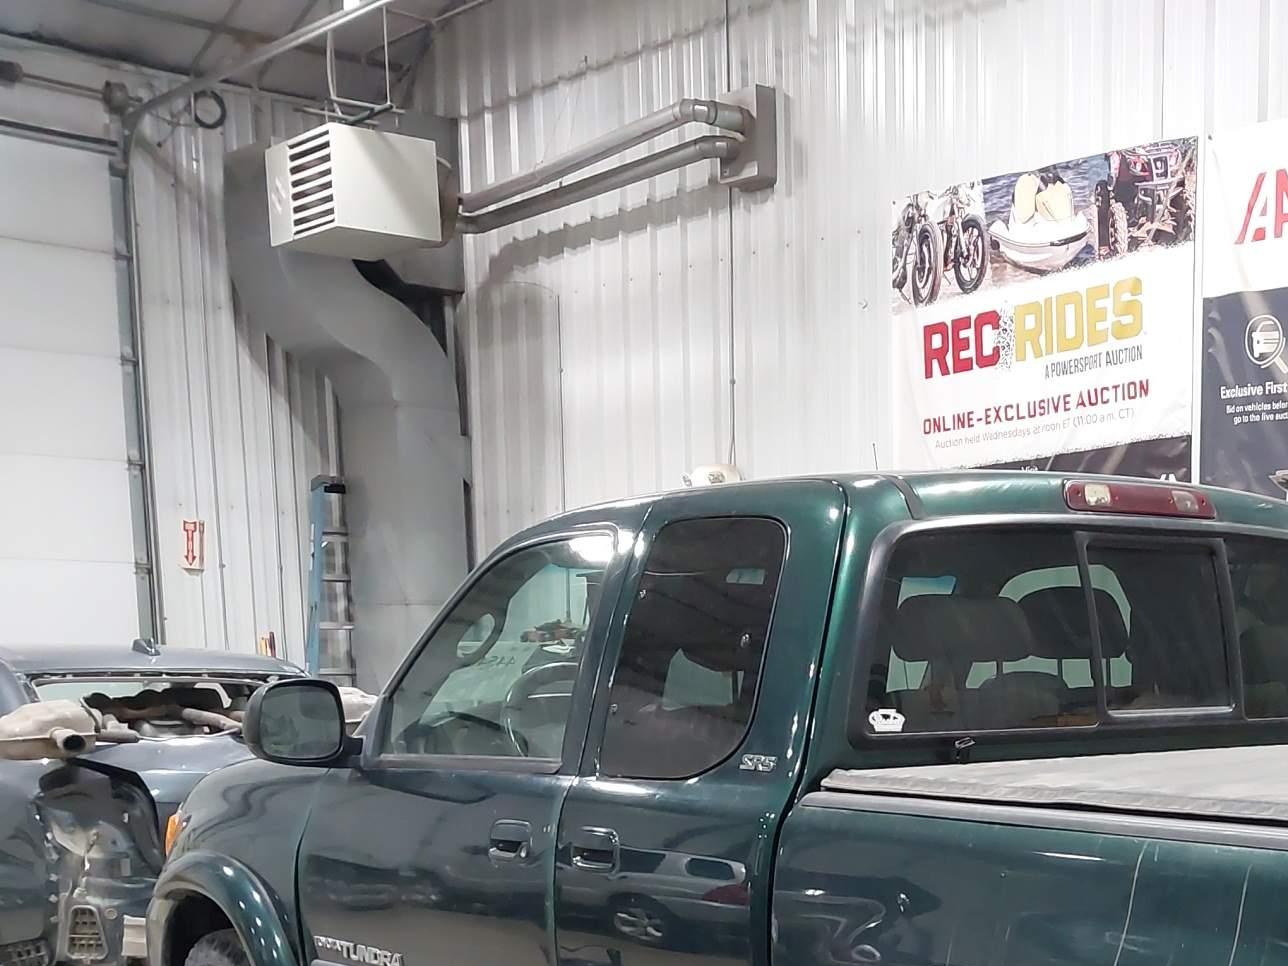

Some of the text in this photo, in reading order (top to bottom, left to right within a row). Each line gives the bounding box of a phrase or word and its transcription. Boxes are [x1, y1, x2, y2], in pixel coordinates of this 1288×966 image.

[923, 276, 1143, 379] REC RIDES
[1044, 345, 1143, 380] A POWERSPORT AUCTION
[1220, 383, 1264, 399] Exclusive
[1265, 381, 1288, 395] First
[923, 379, 1150, 435] ONLINE-EXCLUSIVE AUCTION
[1244, 402, 1271, 412] vehicles
[935, 435, 963, 449] Auction
[739, 754, 778, 772] SR5
